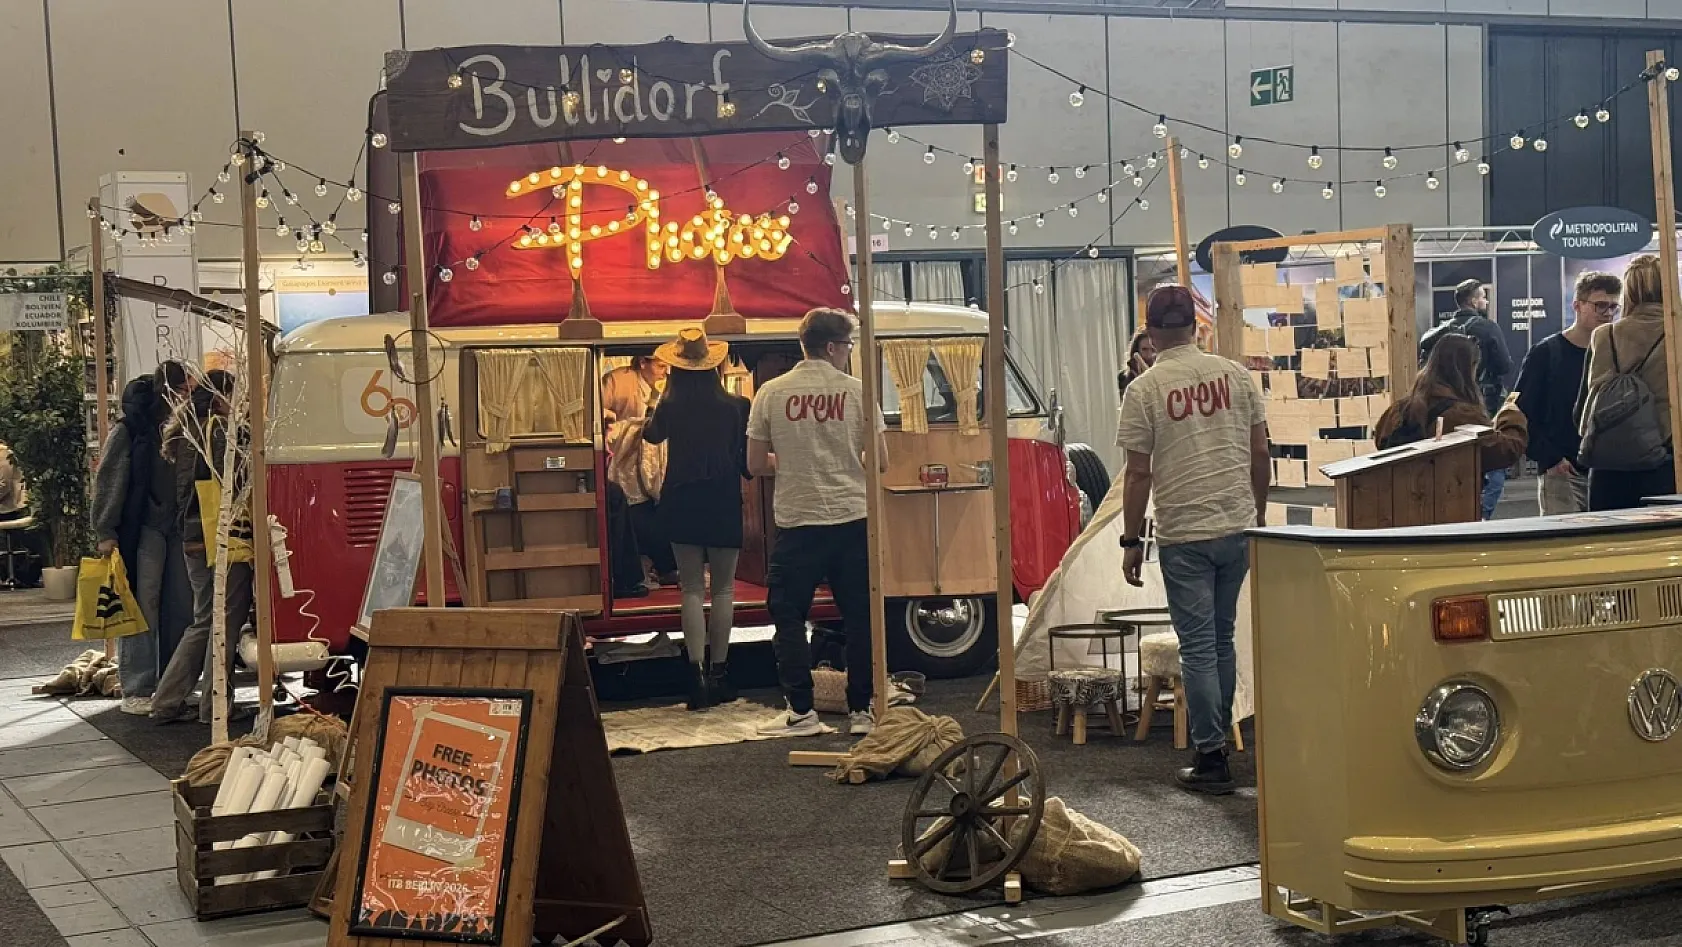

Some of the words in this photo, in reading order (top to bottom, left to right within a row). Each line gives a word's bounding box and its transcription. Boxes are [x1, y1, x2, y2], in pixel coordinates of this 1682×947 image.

[458, 49, 732, 136] Bullidorf
[505, 166, 794, 279] Photos
[1565, 222, 1639, 234] METROPOLITAN
[1562, 236, 1606, 248] TOURING
[38, 294, 60, 302] CHILE
[785, 391, 848, 423] crew
[1166, 373, 1231, 421] crew
[433, 743, 474, 767] FREE
[412, 759, 487, 796] PHOTOS
[387, 879, 403, 889] ITB
[405, 880, 443, 893] BERLIN
